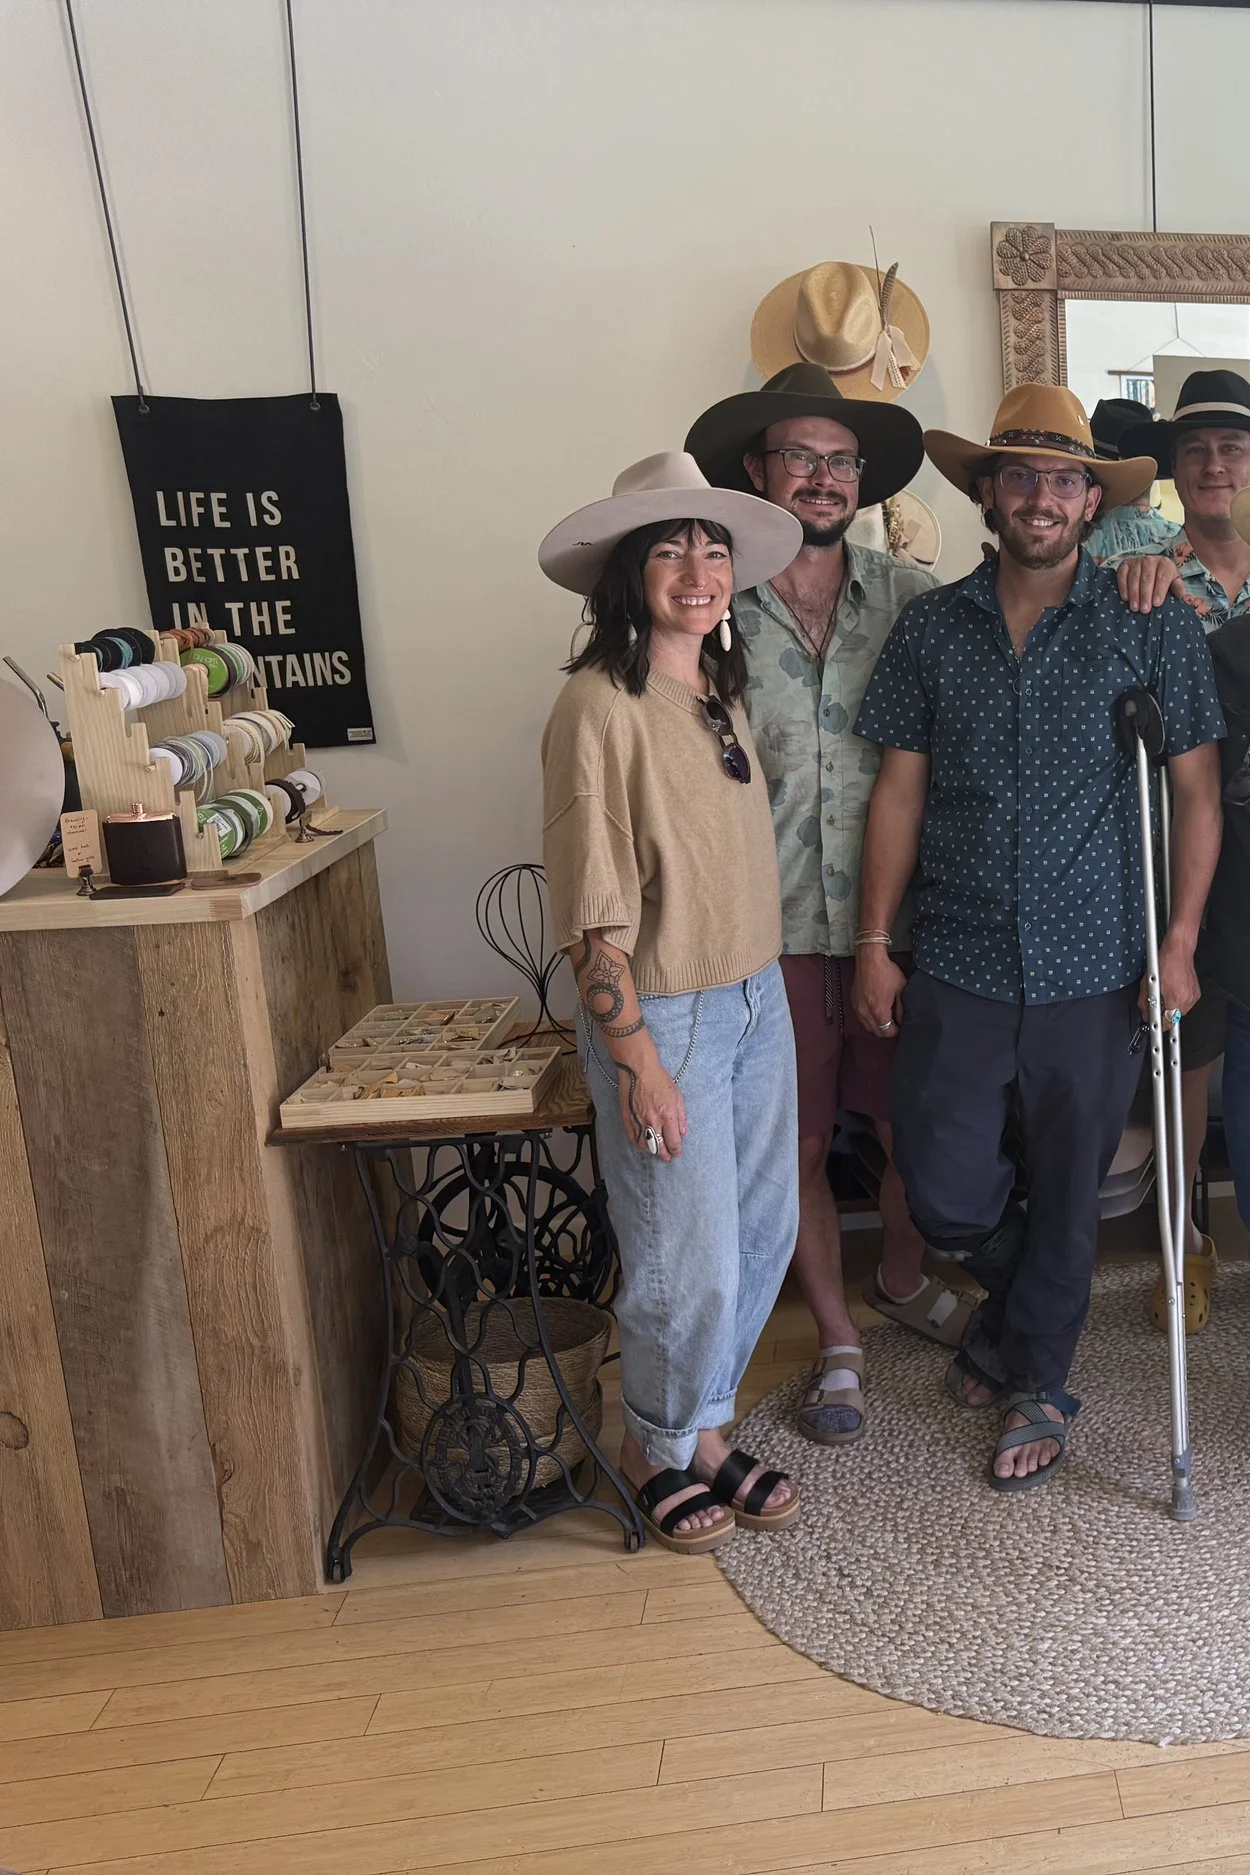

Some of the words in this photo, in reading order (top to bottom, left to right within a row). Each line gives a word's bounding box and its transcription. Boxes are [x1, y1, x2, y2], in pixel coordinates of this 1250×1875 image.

[156, 490, 231, 528] LIFE
[246, 490, 282, 527] IS
[164, 545, 300, 583] BETTER
[172, 602, 208, 631] IN
[224, 600, 297, 637] THE
[251, 650, 352, 690] NTAINS
